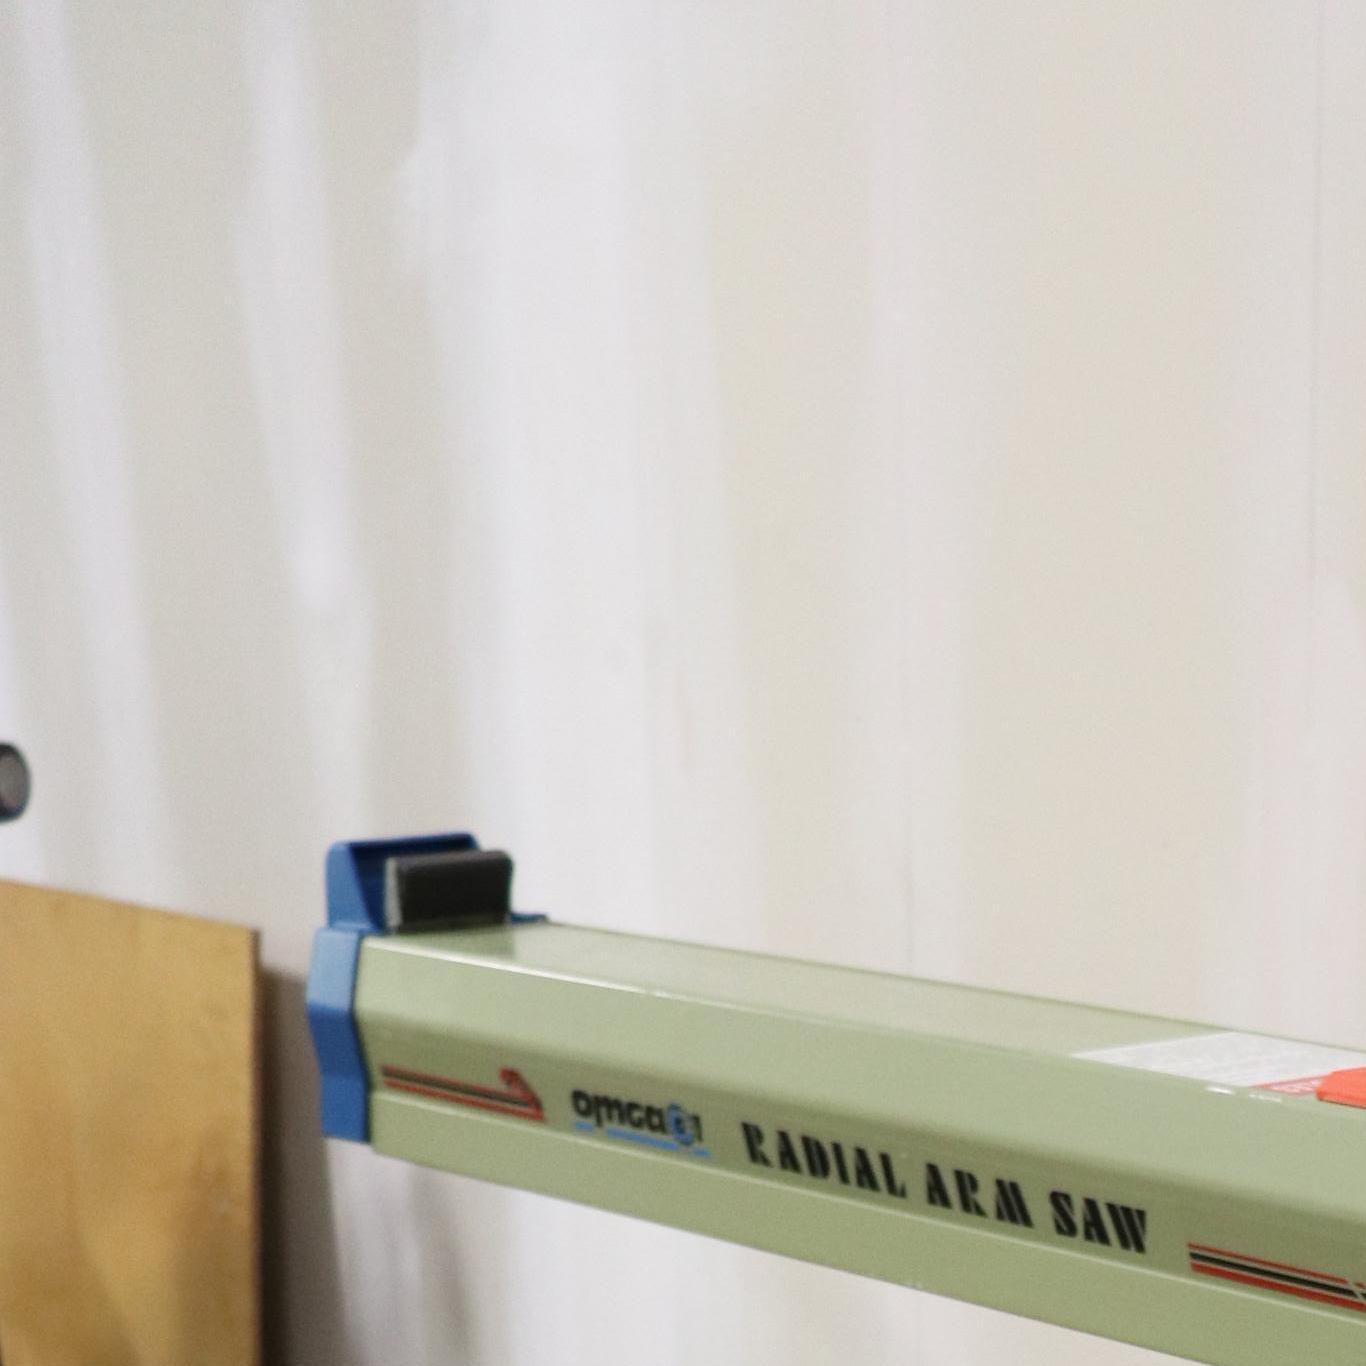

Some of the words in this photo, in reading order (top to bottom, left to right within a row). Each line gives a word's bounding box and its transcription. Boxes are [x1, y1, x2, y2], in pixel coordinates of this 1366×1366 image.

[741, 1121, 907, 1199] RADIAL
[926, 1162, 1035, 1229] ARM
[1048, 1190, 1147, 1254] SAW
